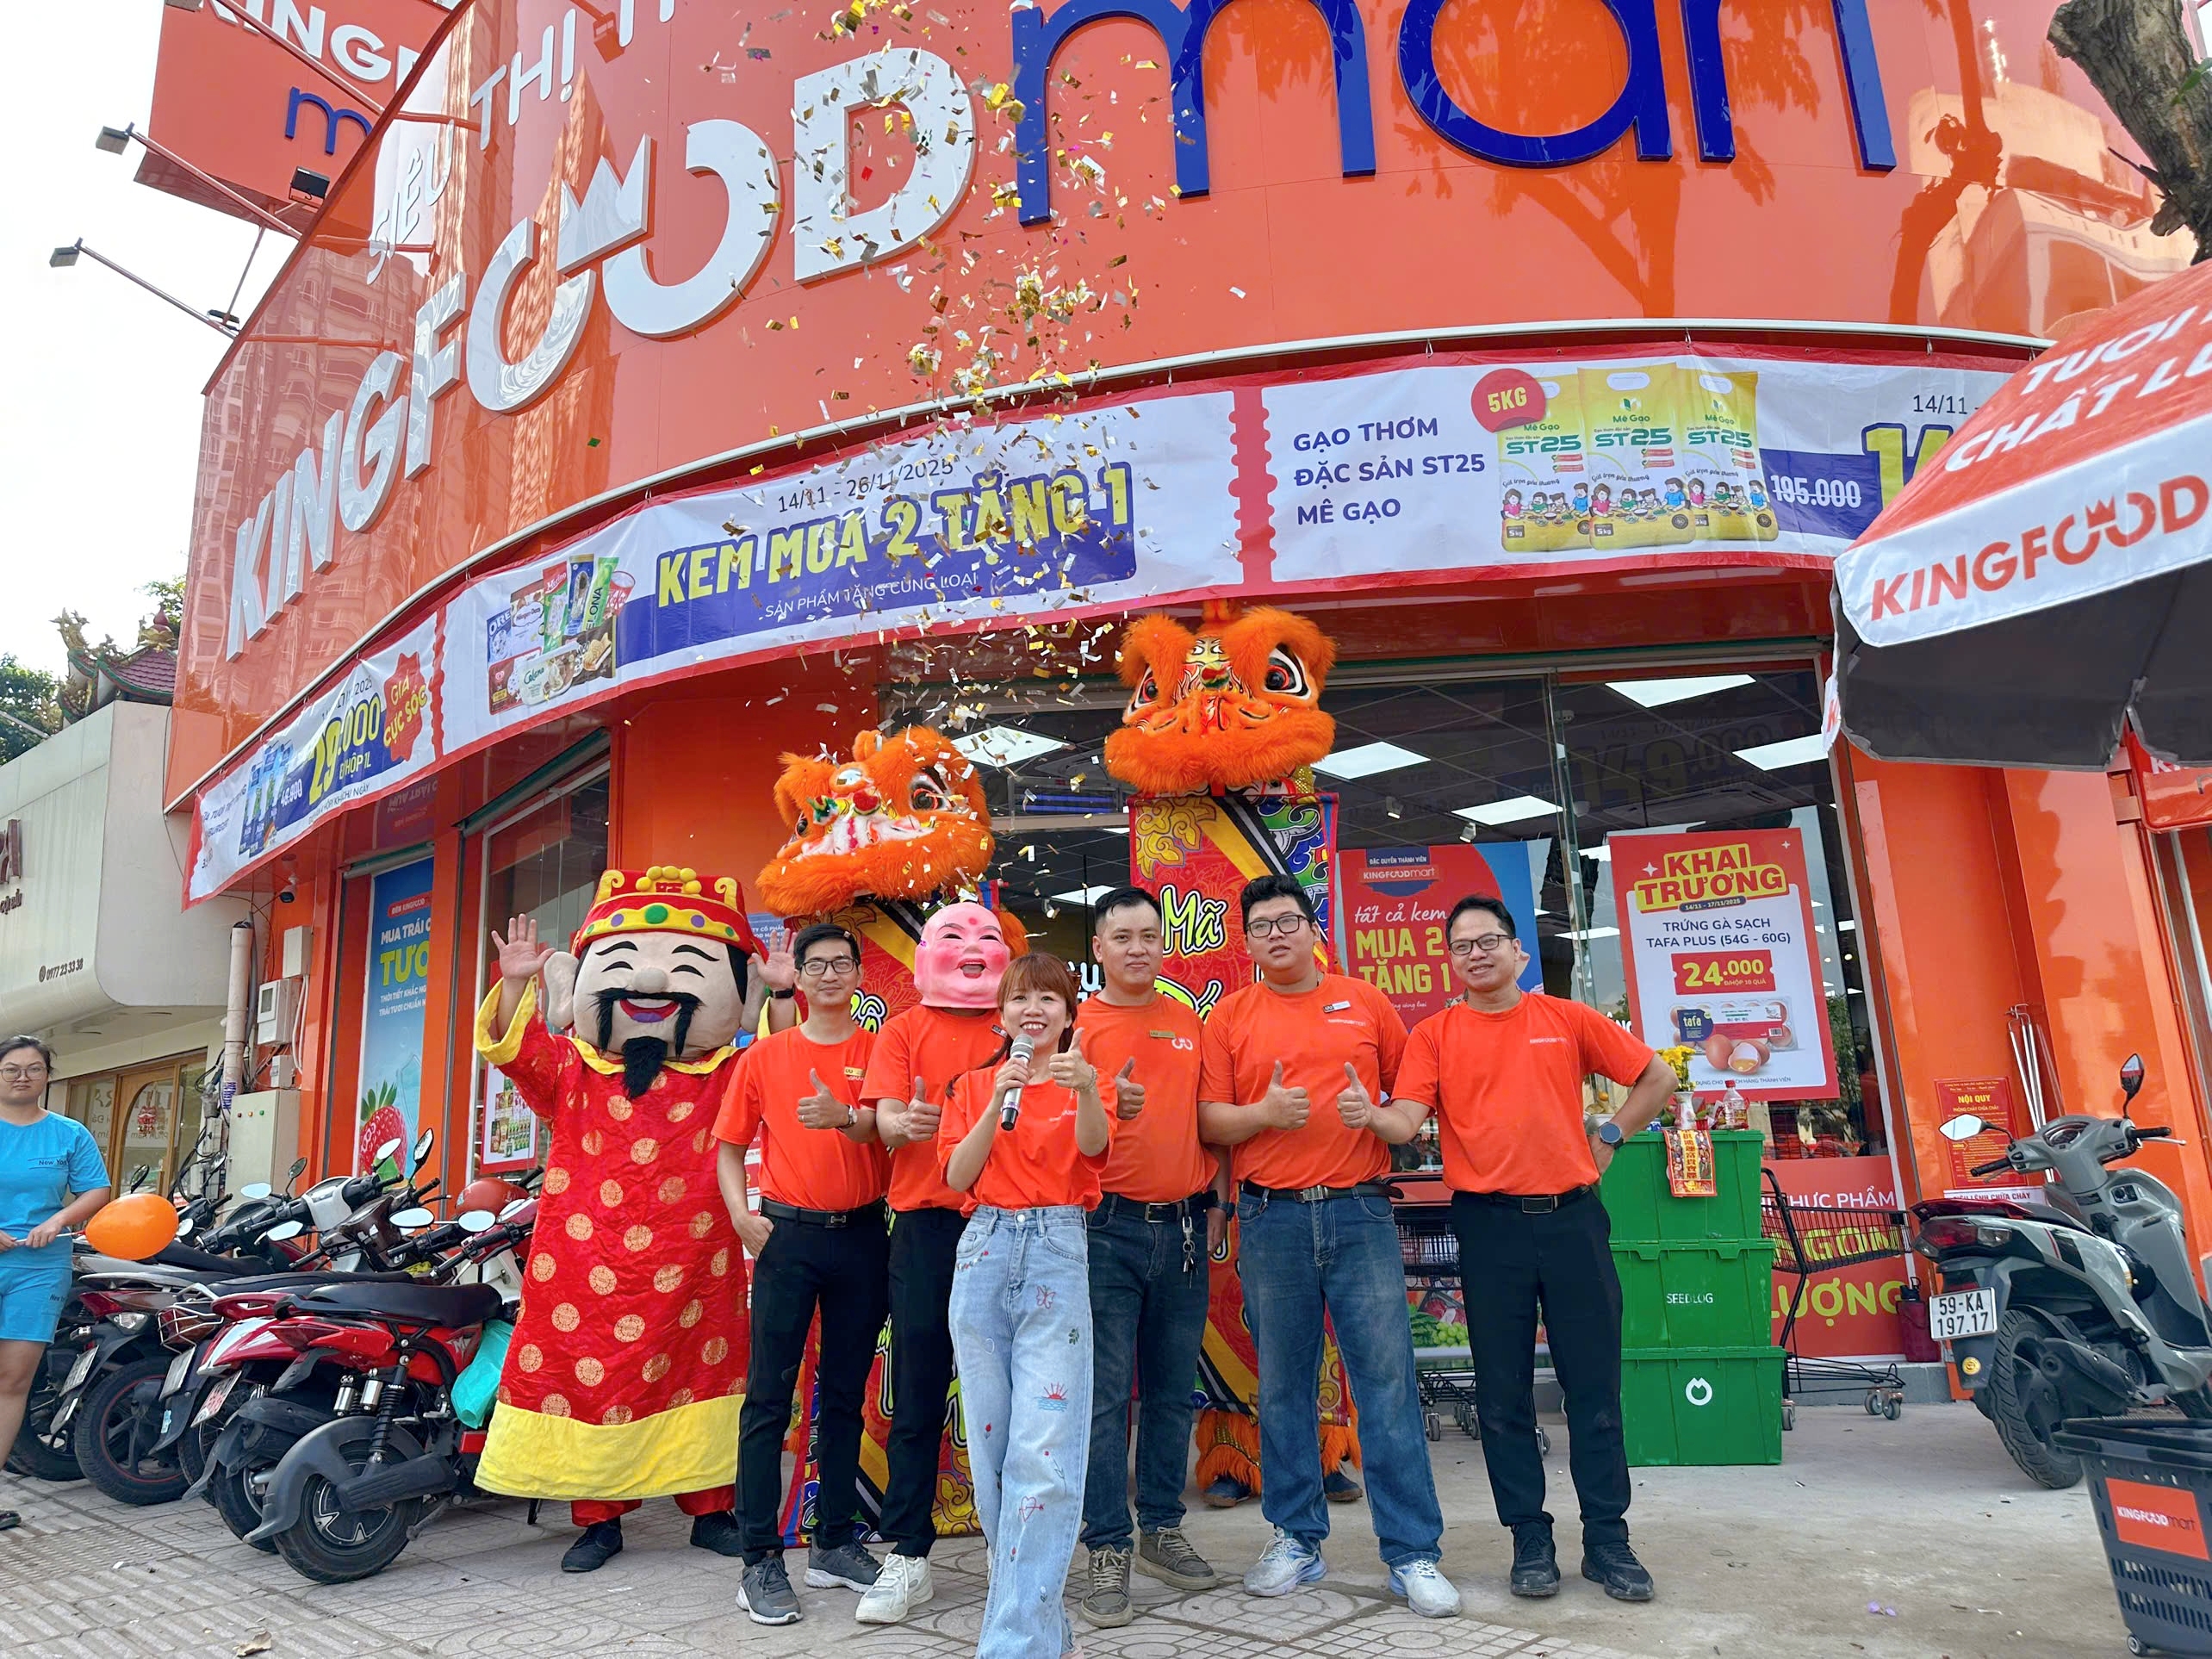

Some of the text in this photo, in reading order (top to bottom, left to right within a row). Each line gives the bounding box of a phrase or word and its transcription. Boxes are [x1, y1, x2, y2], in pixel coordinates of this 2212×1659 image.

[1488, 387, 1528, 413] 5KG
[1913, 395, 1968, 414] 14/11
[1539, 423, 1560, 432] Gạo
[1630, 414, 1650, 425] Gạo
[1945, 373, 2138, 472] CHẤT
[1294, 416, 1438, 453] GẠO THƠM
[1507, 434, 1581, 455] ST25
[1595, 427, 1673, 447] ST25
[1687, 430, 1753, 448] ST25
[1294, 454, 1486, 489] ĐẶC SẢN ST25
[1771, 475, 1861, 508] 195.000
[1297, 498, 1401, 525] MÊ GẠO
[657, 543, 752, 608] KEM
[768, 509, 867, 584] MUA
[885, 501, 921, 557] 2
[1102, 468, 1129, 525] 1
[1870, 475, 2211, 622] KINGFOOD
[798, 587, 840, 612] PHẨM
[941, 572, 978, 589] LOẠI
[586, 587, 603, 630] ELONA
[382, 710, 405, 748] CỰC
[1363, 867, 1436, 879] KINGFOODmart
[1667, 847, 1749, 878] KHAI
[1637, 867, 1783, 905] TRƯƠNG
[1162, 887, 1220, 951] Mã
[1354, 901, 1448, 924] tất cả kem
[1662, 916, 1771, 932] TRỨNG GÀ SẠCH
[381, 917, 425, 945] MUA TRÁI
[1355, 926, 1445, 960] MUA 2
[1646, 937, 1680, 948] TAFA
[1683, 935, 1717, 947] PLUS
[1720, 934, 1750, 948] (54G
[1762, 932, 1792, 945] 60G)
[1440, 962, 1451, 992] 1
[1681, 958, 1765, 988] 24.000
[1683, 1015, 1703, 1028] tafa
[1958, 1095, 1991, 1104] NỘI QUY
[1836, 1185, 1895, 1209] PHẨM
[1771, 1277, 1906, 1327] ƯỢNG
[1939, 1292, 1984, 1315] 59-KA
[1936, 1312, 1989, 1337] 197.17
[2116, 1505, 2197, 1532] KINGFOODmart
